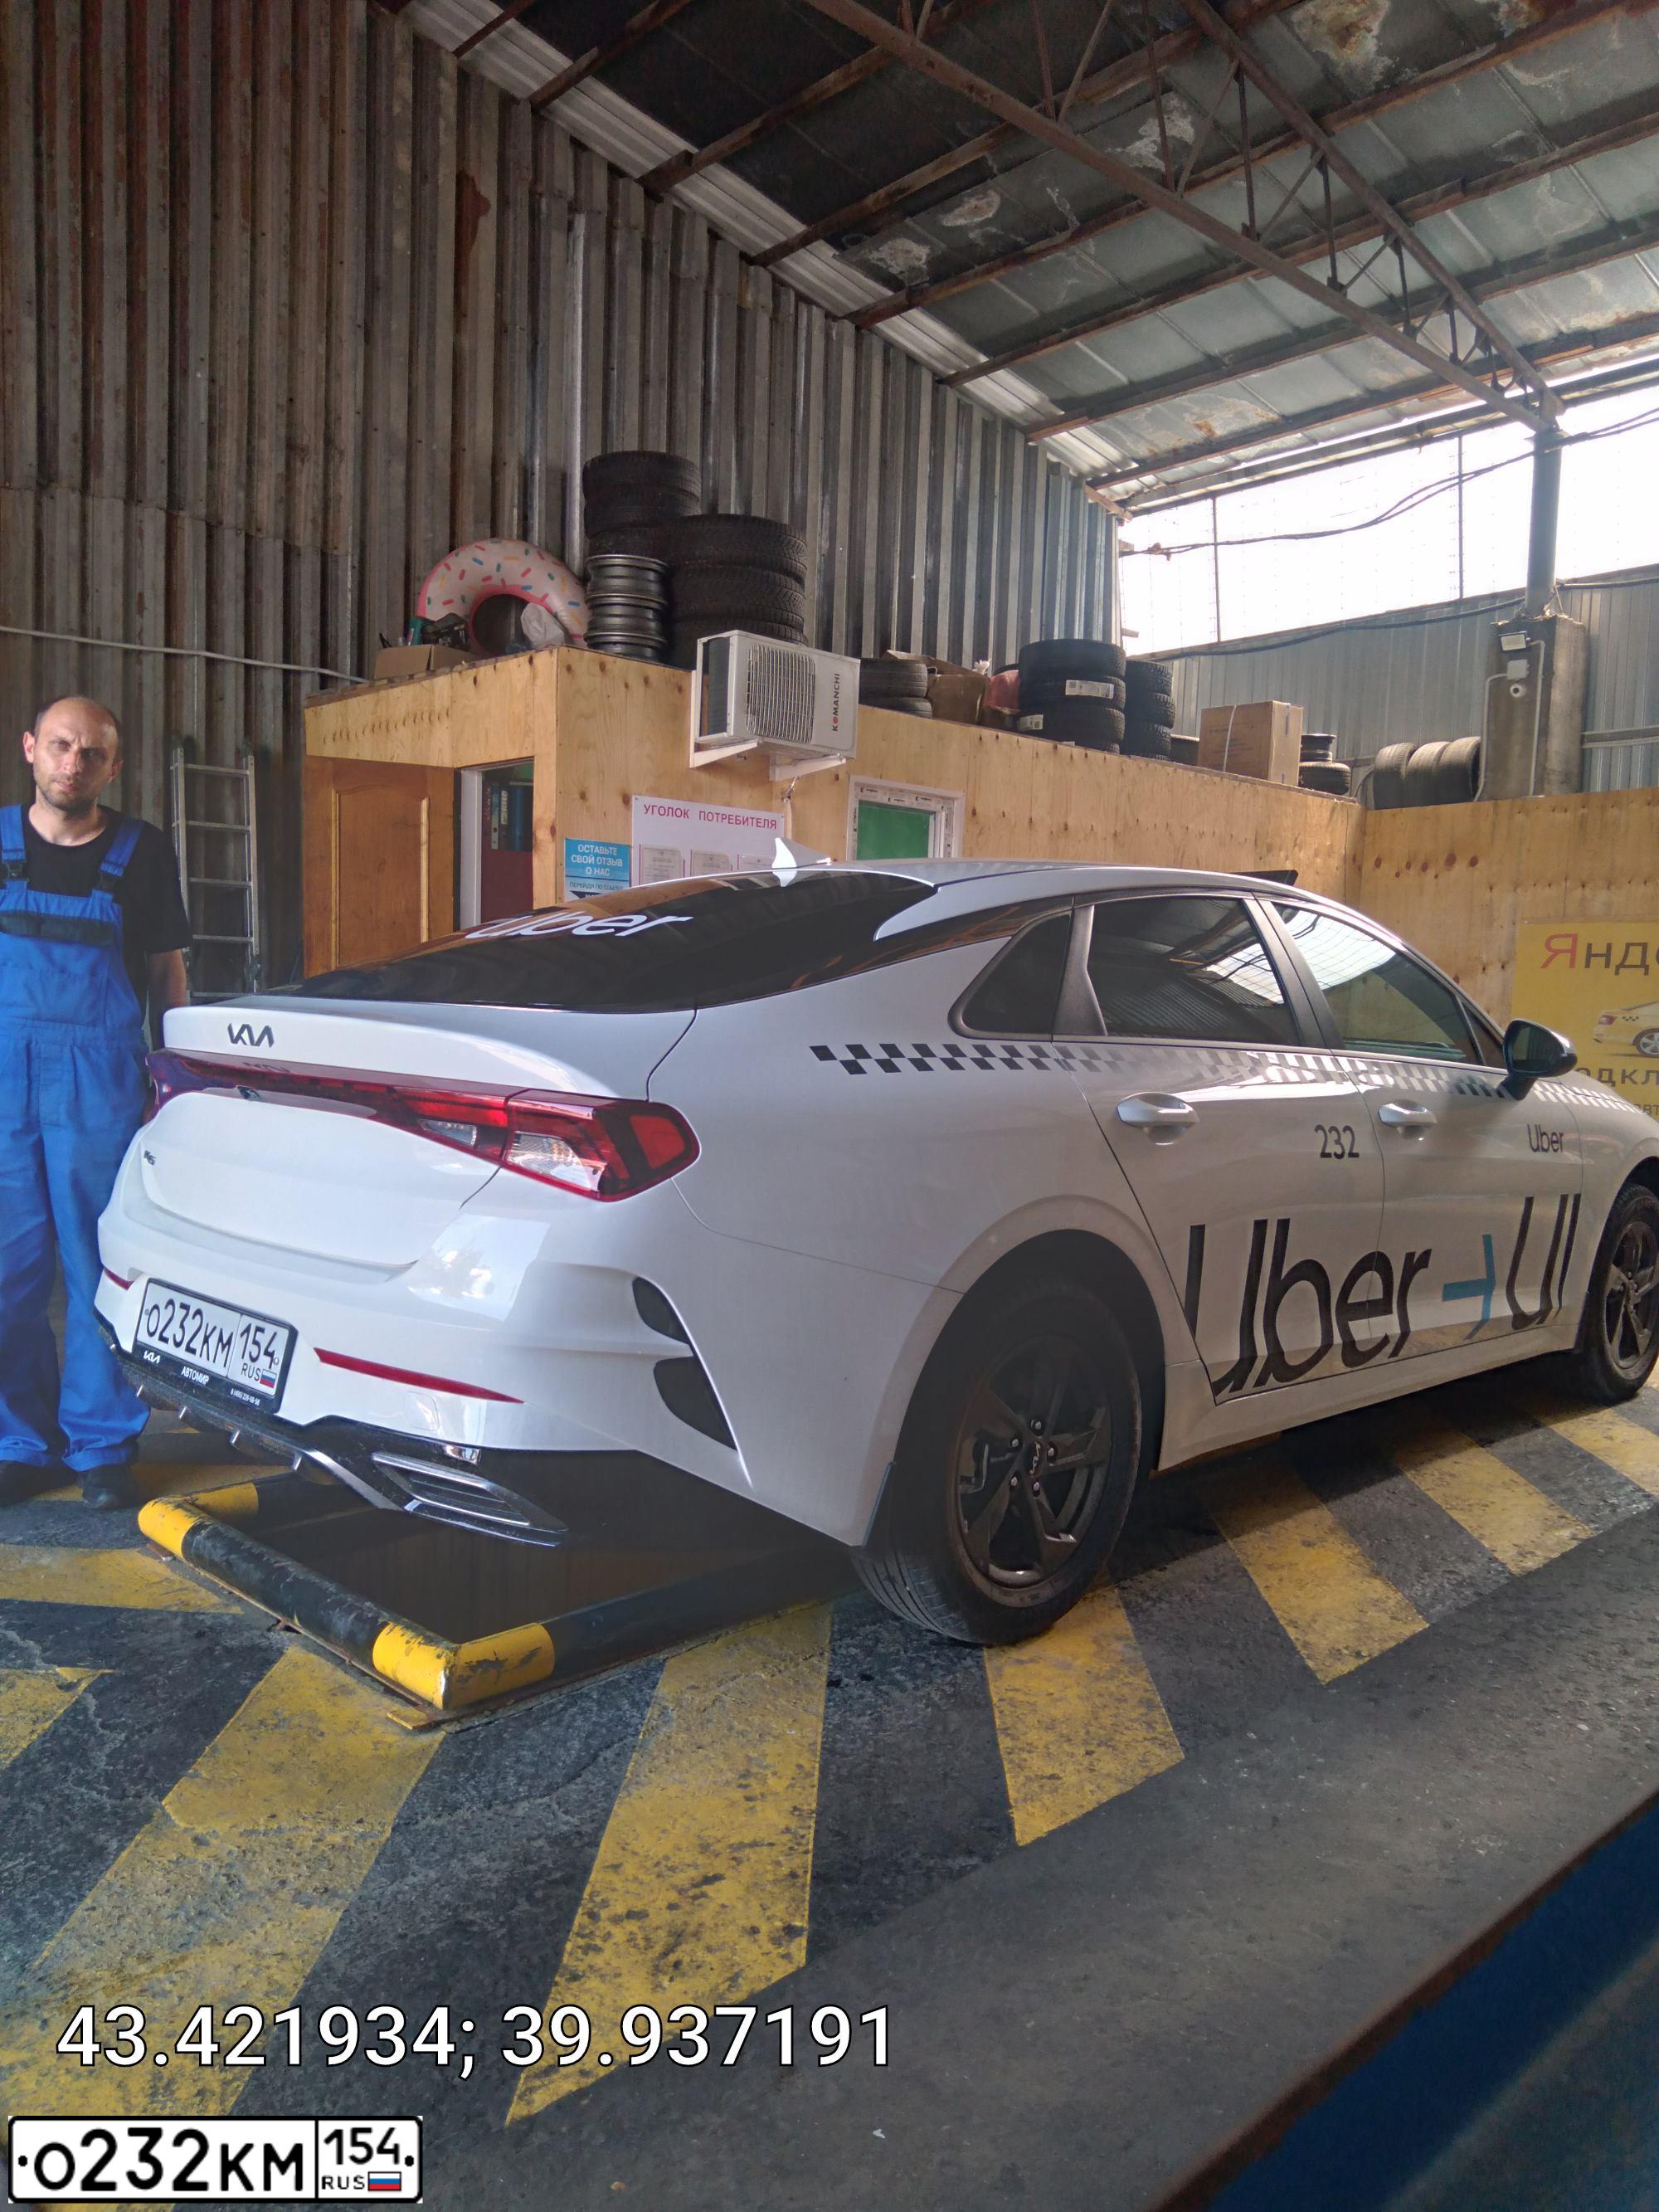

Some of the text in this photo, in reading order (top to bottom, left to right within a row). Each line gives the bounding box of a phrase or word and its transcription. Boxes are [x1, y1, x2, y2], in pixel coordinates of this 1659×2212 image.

[832, 673, 840, 732] KOMANCHI
[644, 804, 777, 830] УГОЛОК ПОТРЕБИТЕЛЯ
[571, 854, 623, 867] СВОЙ ОТЗЫВ
[577, 844, 618, 855] ОСТАВЬТЕ
[586, 866, 611, 876] О НАС
[1540, 933, 1659, 977] Янд
[227, 1022, 275, 1048] KIA
[1314, 1124, 1360, 1159] 232
[1527, 1123, 1564, 1153] Uber
[1185, 1217, 1432, 1397] Uber
[143, 1350, 161, 1364] KIA
[240, 1323, 278, 1370] 154
[181, 1366, 210, 1386] АВТОМИР
[241, 1362, 260, 1381] RUS
